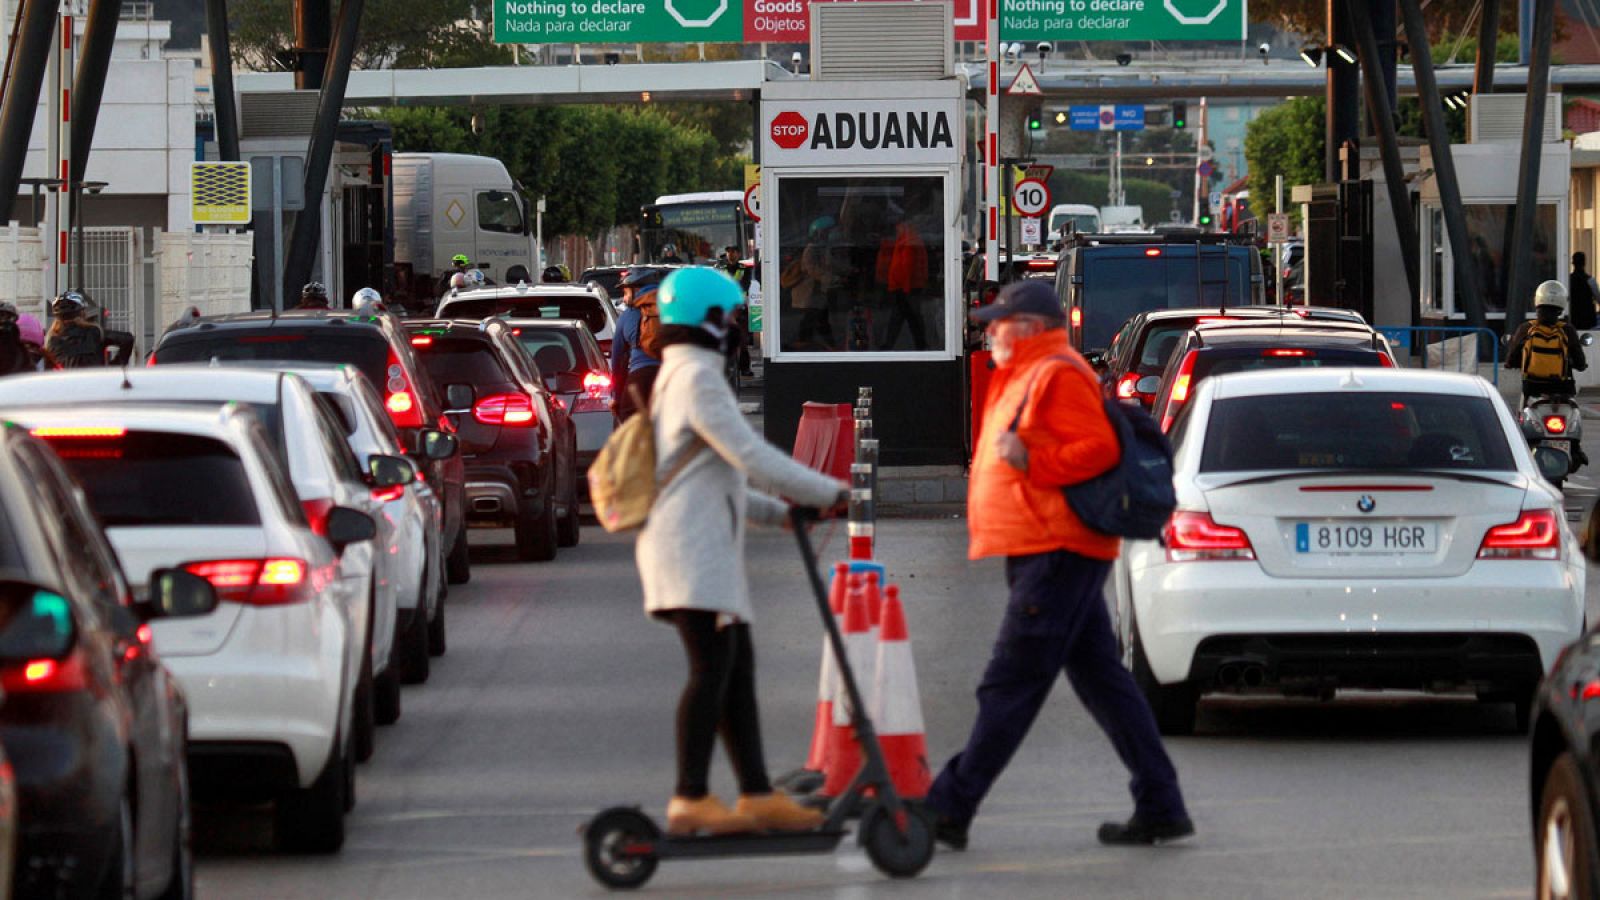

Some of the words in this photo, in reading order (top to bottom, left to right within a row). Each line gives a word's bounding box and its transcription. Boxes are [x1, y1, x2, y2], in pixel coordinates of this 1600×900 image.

[506, 0, 566, 17] Nothing
[571, 1, 588, 14] to
[591, 0, 646, 14] declare
[754, 0, 803, 13] Goods
[1004, 0, 1065, 15] Nothing
[1070, 0, 1086, 11] to
[1090, 0, 1145, 12] declare
[505, 18, 541, 32] Nada
[546, 21, 575, 35] para
[579, 17, 632, 32] declarar
[754, 17, 806, 34] Objetos
[1003, 15, 1039, 29] Nada
[1043, 18, 1073, 32] para
[1077, 15, 1131, 29] declarar
[773, 125, 806, 136] STOP
[810, 111, 954, 150] ADUANA
[1020, 188, 1043, 206] 10
[1317, 526, 1373, 549] 8109
[1383, 526, 1426, 549] HGR
